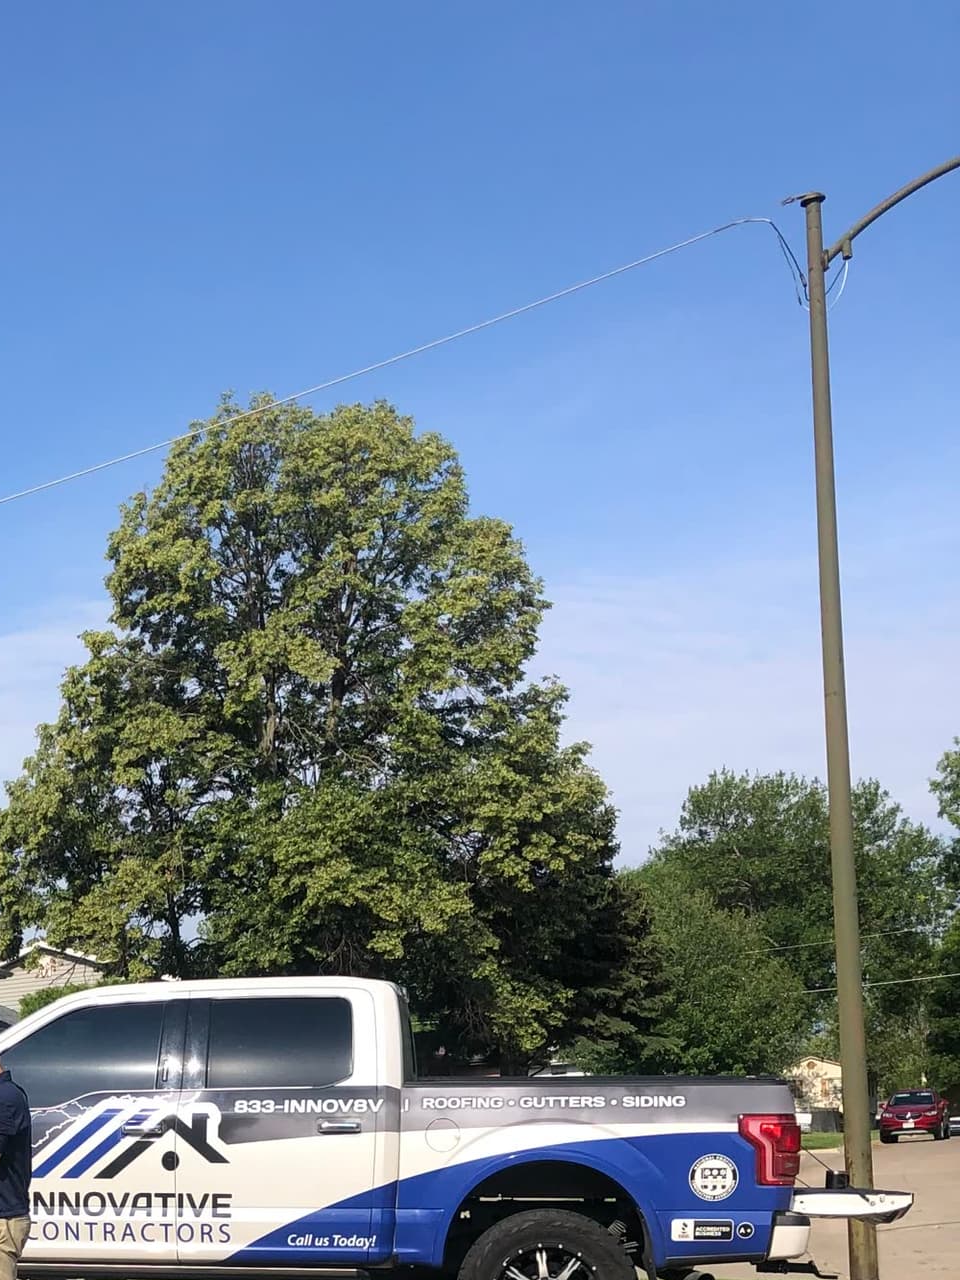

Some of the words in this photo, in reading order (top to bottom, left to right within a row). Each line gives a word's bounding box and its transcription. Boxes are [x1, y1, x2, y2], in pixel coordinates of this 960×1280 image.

[234, 1098, 384, 1113] 833-INNOV8V
[422, 1097, 503, 1109] ROOFING
[519, 1096, 606, 1108] GUTTERS
[622, 1095, 686, 1108] SIDING
[33, 1191, 232, 1218] NNOVATIVE
[287, 1234, 313, 1246] Call
[315, 1237, 330, 1246] us
[332, 1235, 377, 1250] Today!
